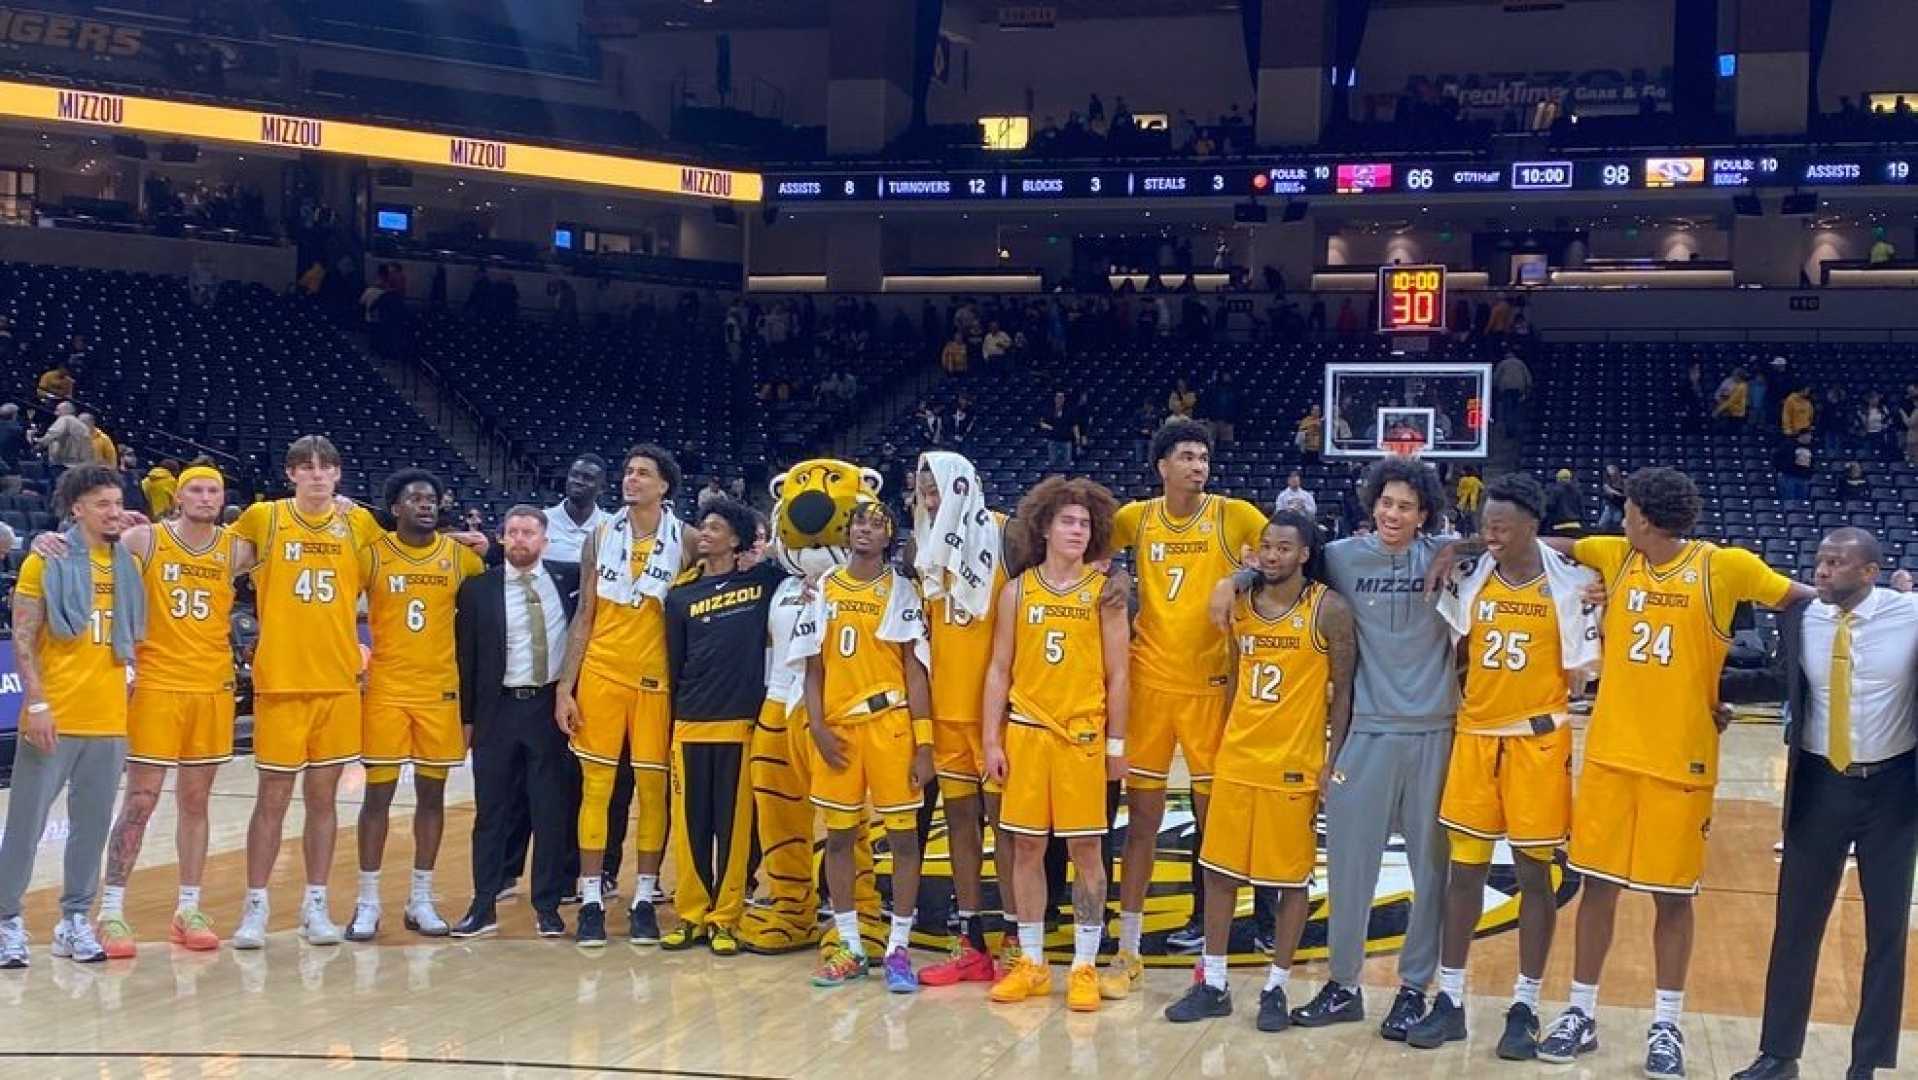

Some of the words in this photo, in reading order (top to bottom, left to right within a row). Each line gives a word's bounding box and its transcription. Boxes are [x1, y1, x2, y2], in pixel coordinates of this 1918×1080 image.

[57, 91, 123, 123] MIZZOU
[261, 116, 321, 147] MIZZOU
[450, 139, 506, 168] MIZZOU
[1315, 166, 1330, 179] 10
[1602, 165, 1630, 185] 98
[1761, 158, 1778, 172] 10
[1806, 164, 1860, 178] ASSISTS
[1887, 162, 1909, 178] 19
[681, 168, 732, 196] MIZZOU
[1022, 179, 1063, 192] BLOCKS
[1090, 177, 1102, 192] 3
[1144, 177, 1186, 190] STEALS
[1213, 175, 1225, 190] 3
[1407, 169, 1433, 188] 66
[1521, 168, 1565, 184] 10:00
[779, 182, 821, 194] ASSISTS
[845, 180, 855, 194] 8
[888, 181, 950, 194] TURNOVERS
[968, 179, 986, 194] 12
[1393, 271, 1439, 291] 10:00
[1392, 291, 1433, 324] 30
[284, 541, 342, 560] MISSOURI
[1151, 541, 1208, 561] MISSOURI
[161, 562, 222, 582] MISSOURI
[294, 568, 336, 603] 45
[388, 574, 449, 593] MISSOURI
[1167, 567, 1185, 601] 7
[170, 587, 211, 620] 35
[689, 584, 763, 618] MIZZOU
[1627, 588, 1689, 612] MISSOURI
[407, 598, 426, 632] 6
[1028, 604, 1090, 624] MISSOURI
[1479, 600, 1548, 621] MISSOURI
[839, 625, 857, 658] 0
[1045, 630, 1067, 665] 5
[1240, 635, 1300, 655] MISSOURI
[1482, 629, 1531, 670] 25
[1628, 621, 1674, 666] 24
[1250, 662, 1281, 702] 12
